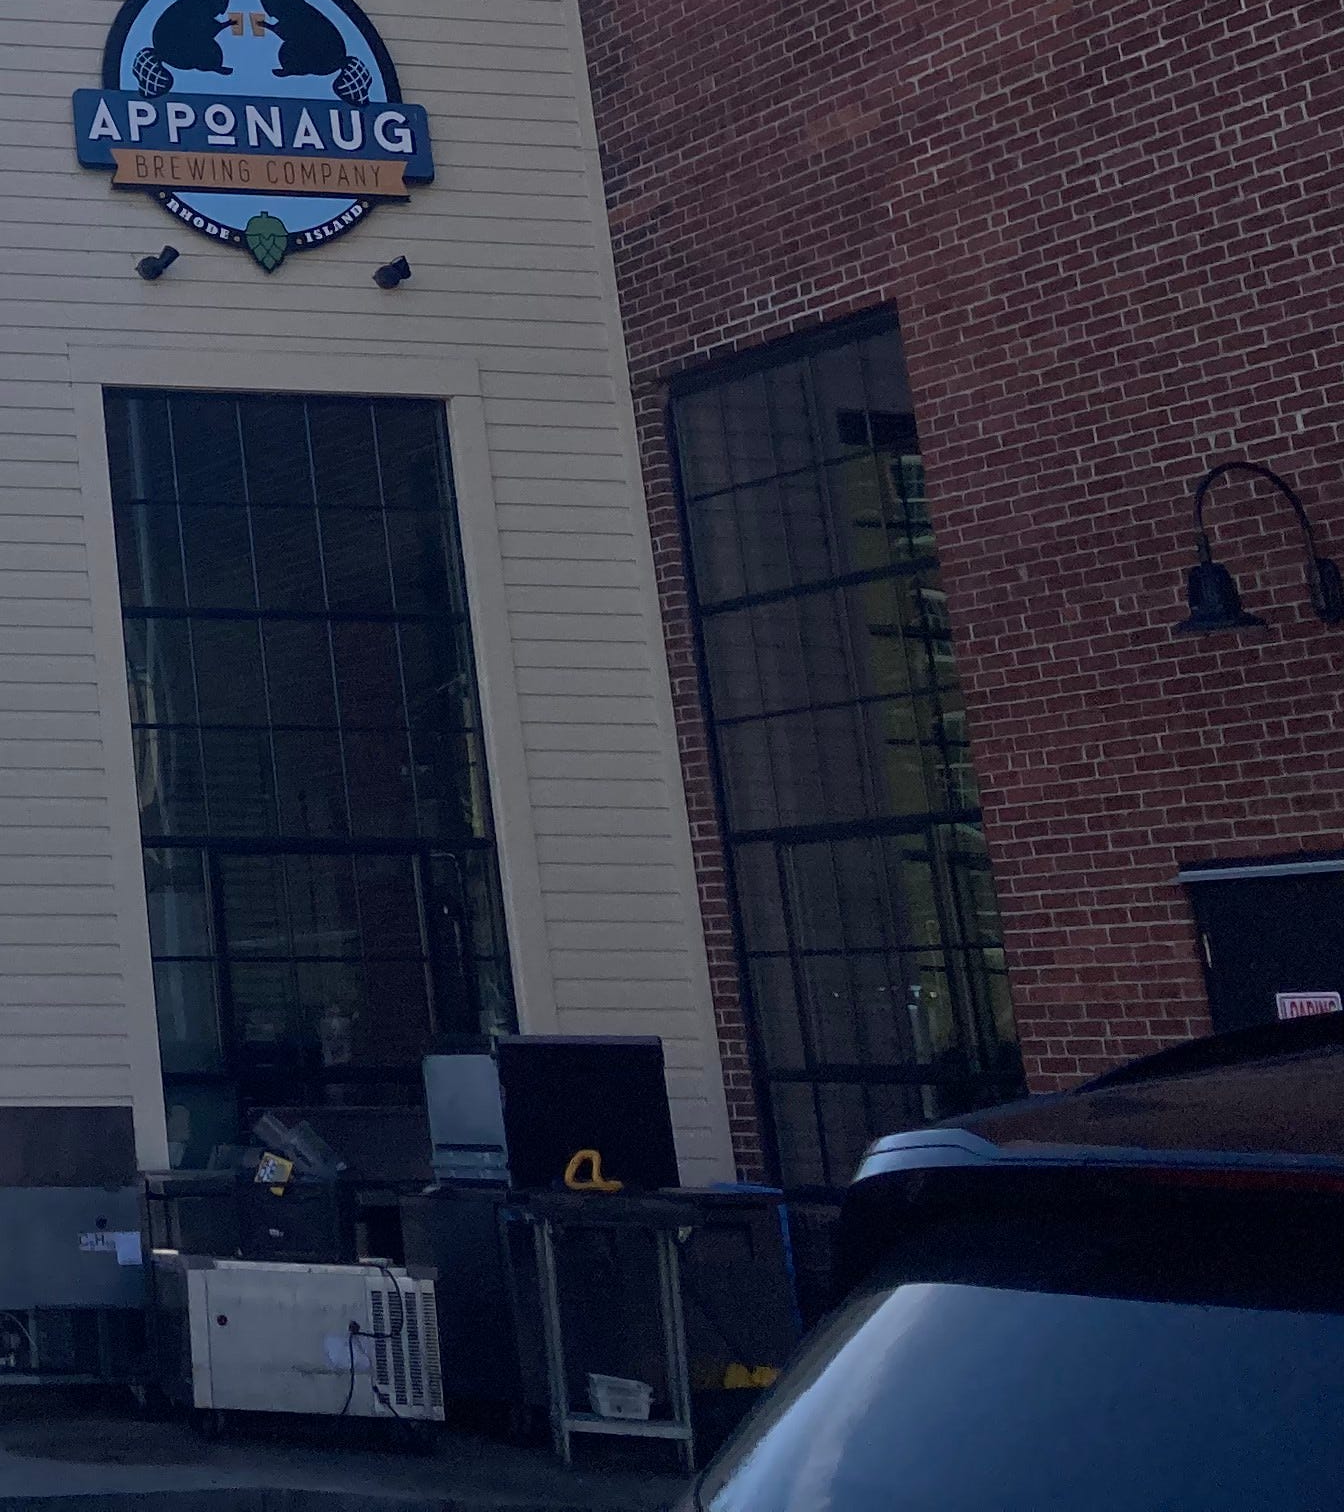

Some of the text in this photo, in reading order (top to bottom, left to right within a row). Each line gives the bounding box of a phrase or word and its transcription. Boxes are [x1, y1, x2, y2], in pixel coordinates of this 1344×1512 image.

[88, 98, 414, 154] APPONAUG
[135, 154, 382, 188] BREWING COMPANY
[165, 197, 364, 244] RHODE ISLAND
